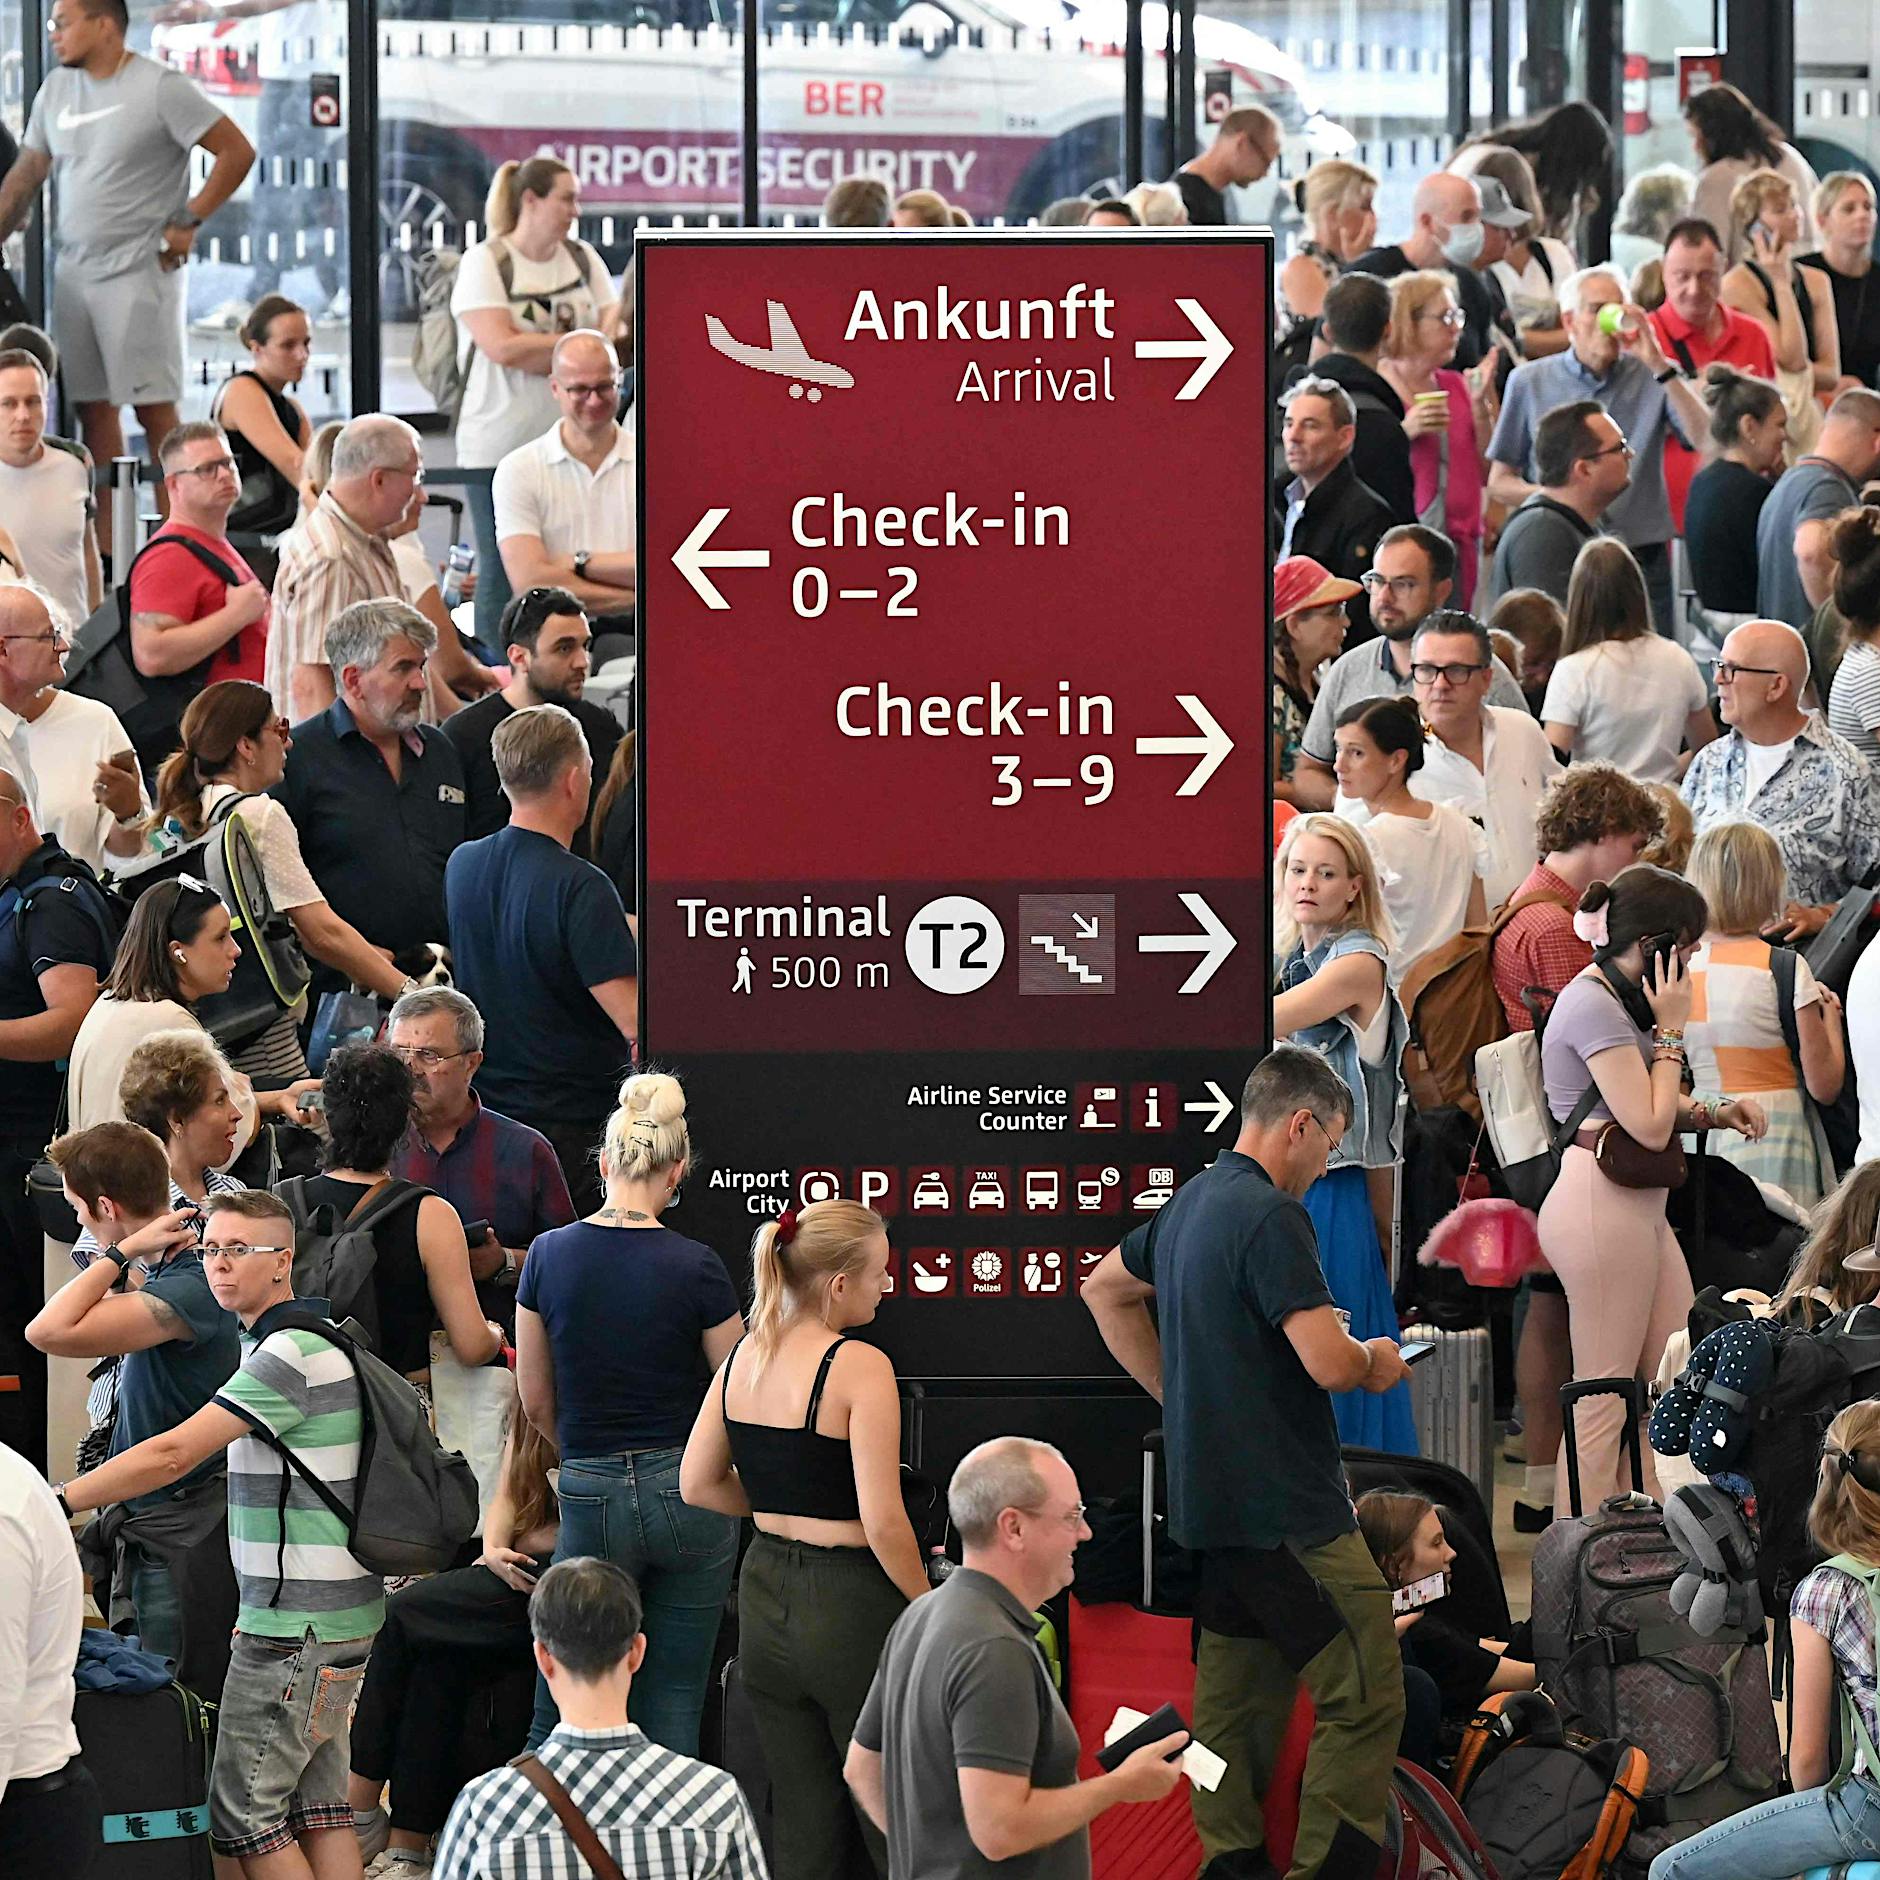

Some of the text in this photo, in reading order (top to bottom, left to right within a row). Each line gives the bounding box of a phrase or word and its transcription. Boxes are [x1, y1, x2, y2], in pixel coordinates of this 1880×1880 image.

[805, 81, 885, 116] BER
[844, 282, 1115, 341] Ankunft
[956, 357, 1115, 402] Arrival
[791, 491, 1069, 548] Check-in
[836, 680, 1114, 737] Check-in
[676, 895, 891, 938] Terminal
[918, 921, 988, 969] T2
[772, 956, 889, 989] 500 m
[907, 1085, 1067, 1106] Airline Service
[979, 1111, 1067, 1131] Counter
[708, 1168, 790, 1193] Airport
[861, 1171, 889, 1210] P
[975, 1172, 997, 1181] TAXI
[1152, 1170, 1171, 1184] DB
[746, 1194, 790, 1219] City
[973, 1283, 1002, 1293] Polizei
